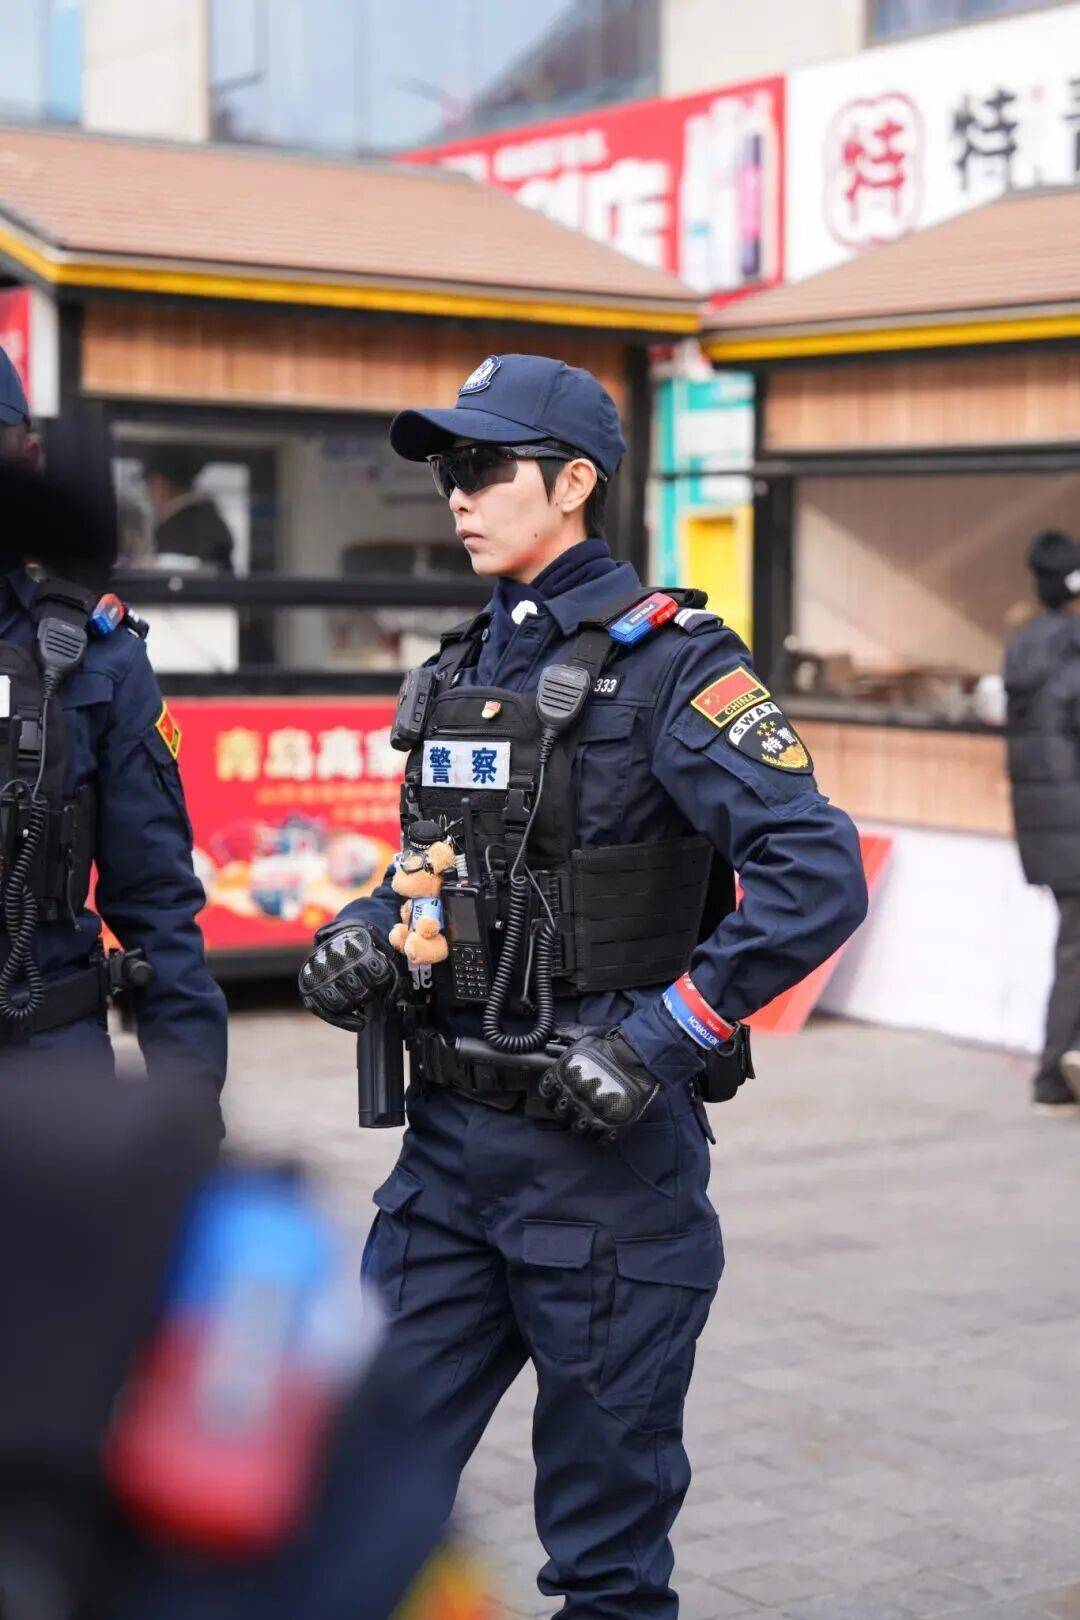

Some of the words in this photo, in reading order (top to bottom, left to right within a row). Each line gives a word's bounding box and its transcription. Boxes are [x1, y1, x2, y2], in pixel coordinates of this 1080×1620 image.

[593, 678, 617, 693] 333
[724, 693, 757, 716] CHINA
[732, 703, 775, 737] SWAT
[429, 746, 498, 785] 警察
